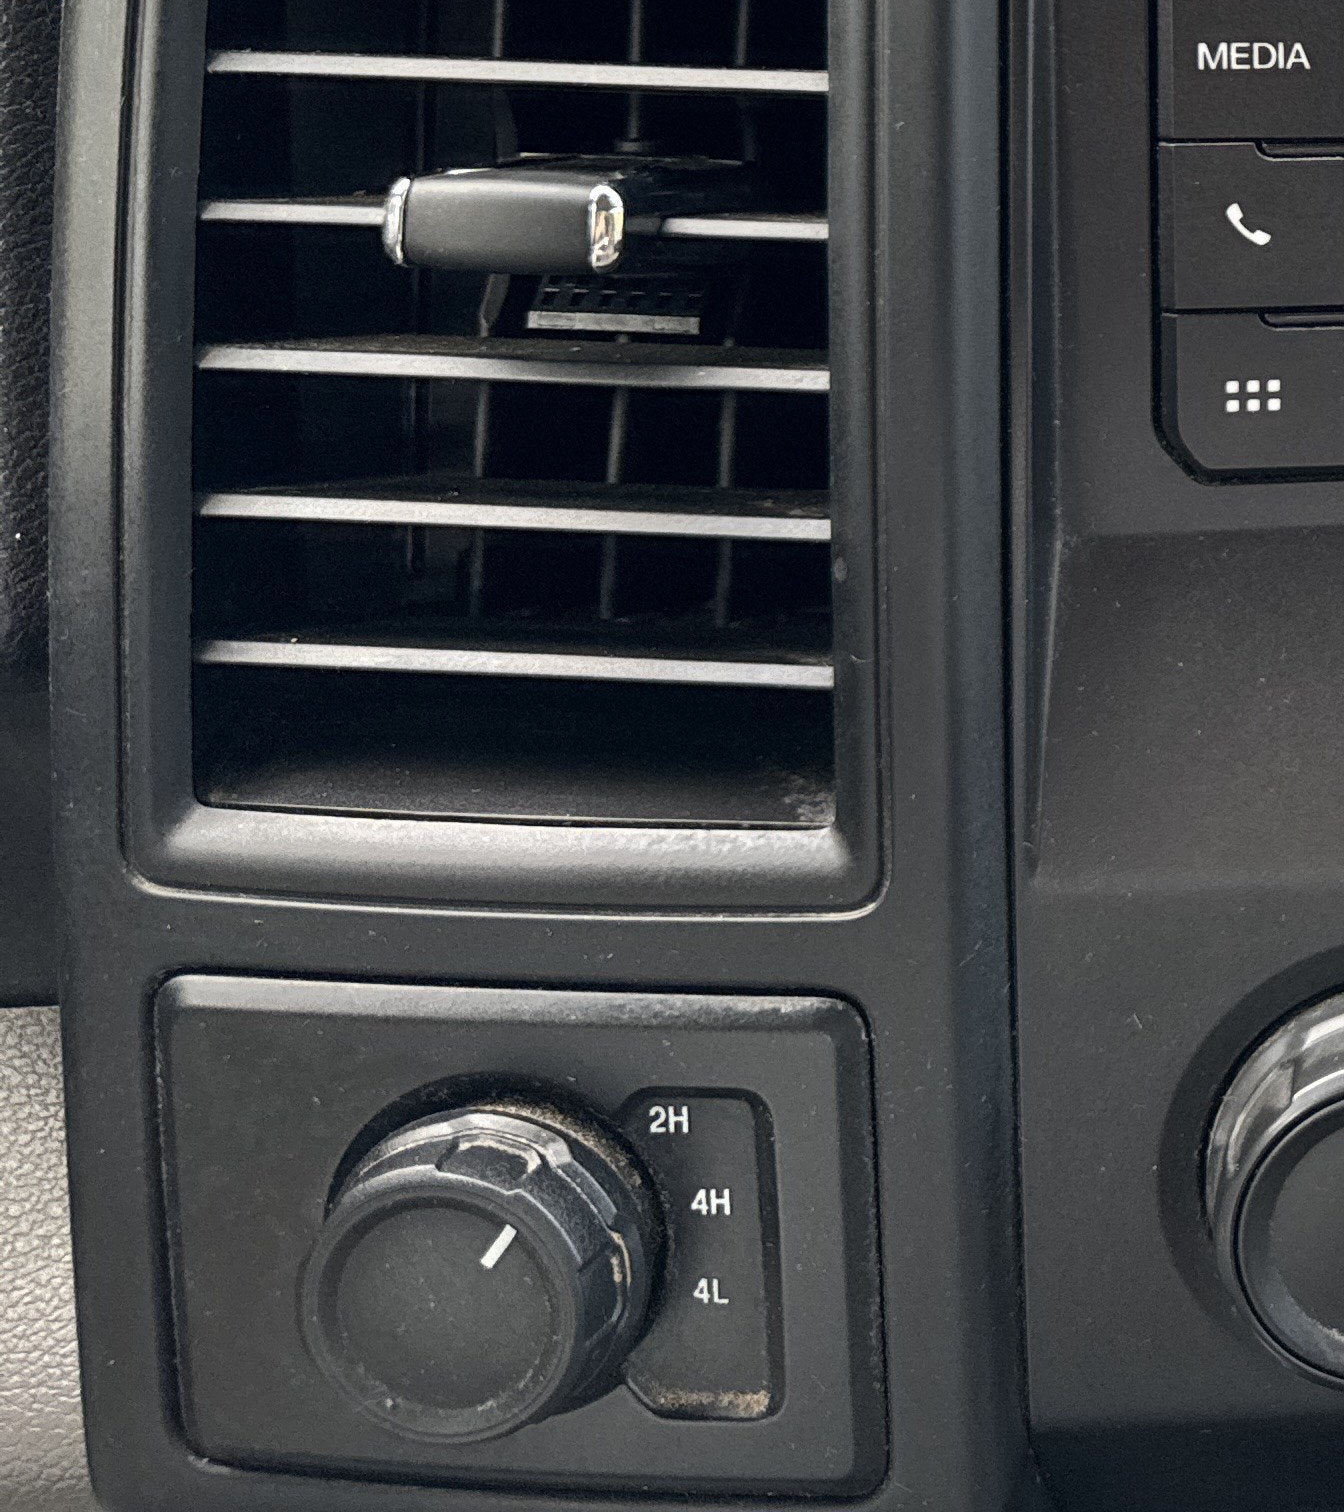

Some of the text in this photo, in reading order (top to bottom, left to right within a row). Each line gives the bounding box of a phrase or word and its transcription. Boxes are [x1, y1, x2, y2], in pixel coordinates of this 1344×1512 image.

[1197, 41, 1311, 71] MEDIA
[649, 1105, 689, 1134] 2H
[690, 1188, 731, 1216] 4H
[692, 1277, 730, 1305] 4L
